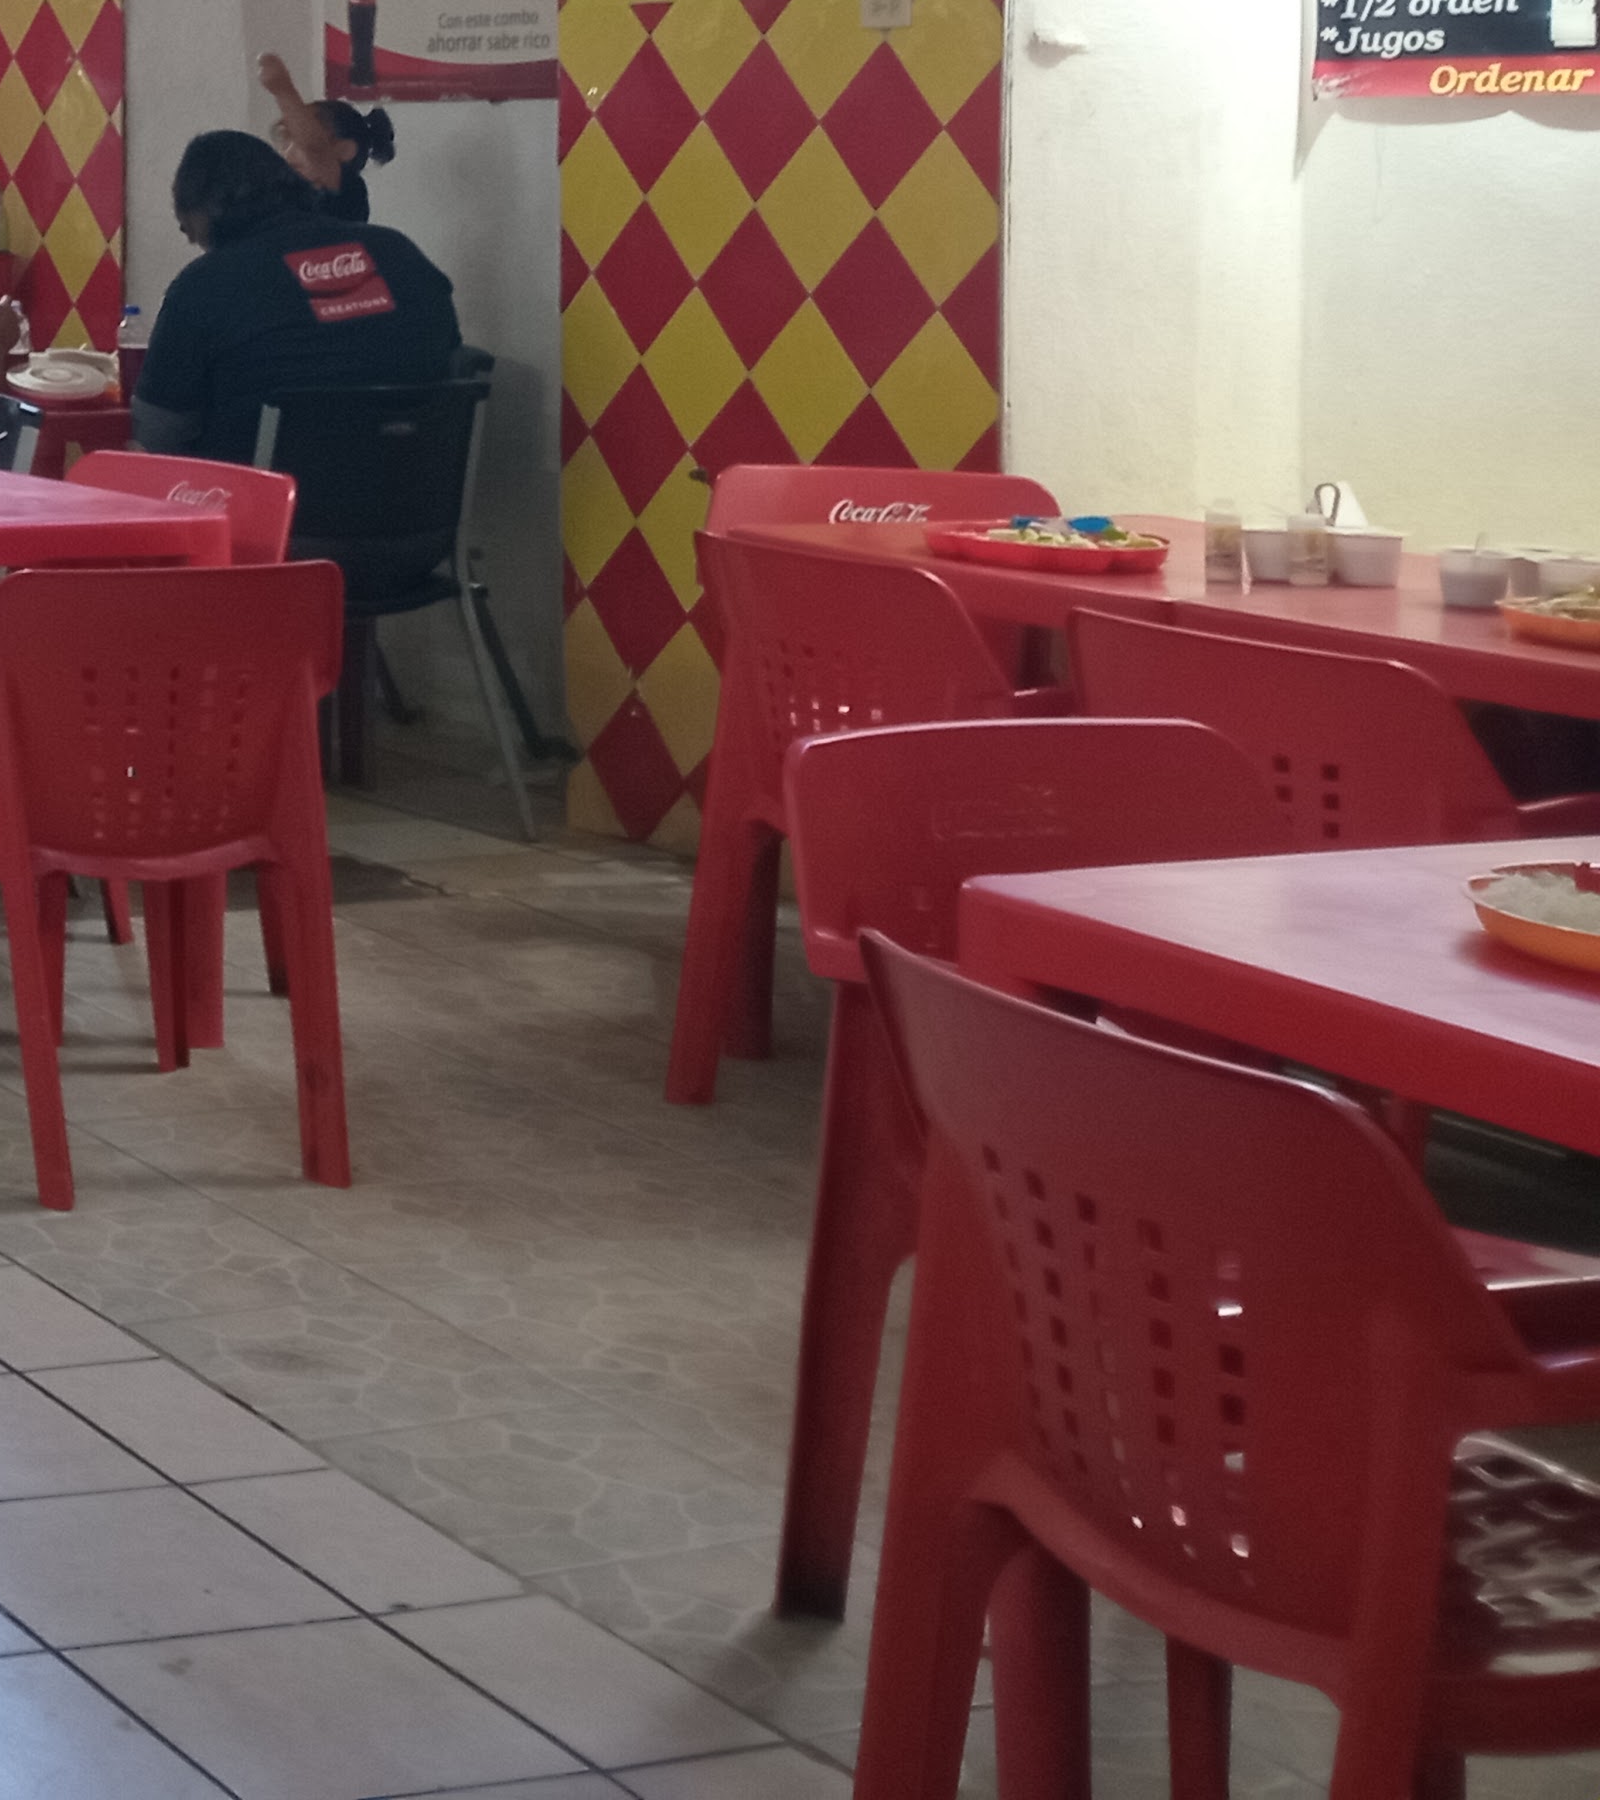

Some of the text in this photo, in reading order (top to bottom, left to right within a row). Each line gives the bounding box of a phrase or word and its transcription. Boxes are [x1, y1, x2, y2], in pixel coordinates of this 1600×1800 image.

[438, 10, 539, 30] Con este combo
[427, 29, 550, 54] ahorrar sabe rico
[1429, 62, 1595, 97] Ordenar
[321, 296, 388, 316] CREATIONS
